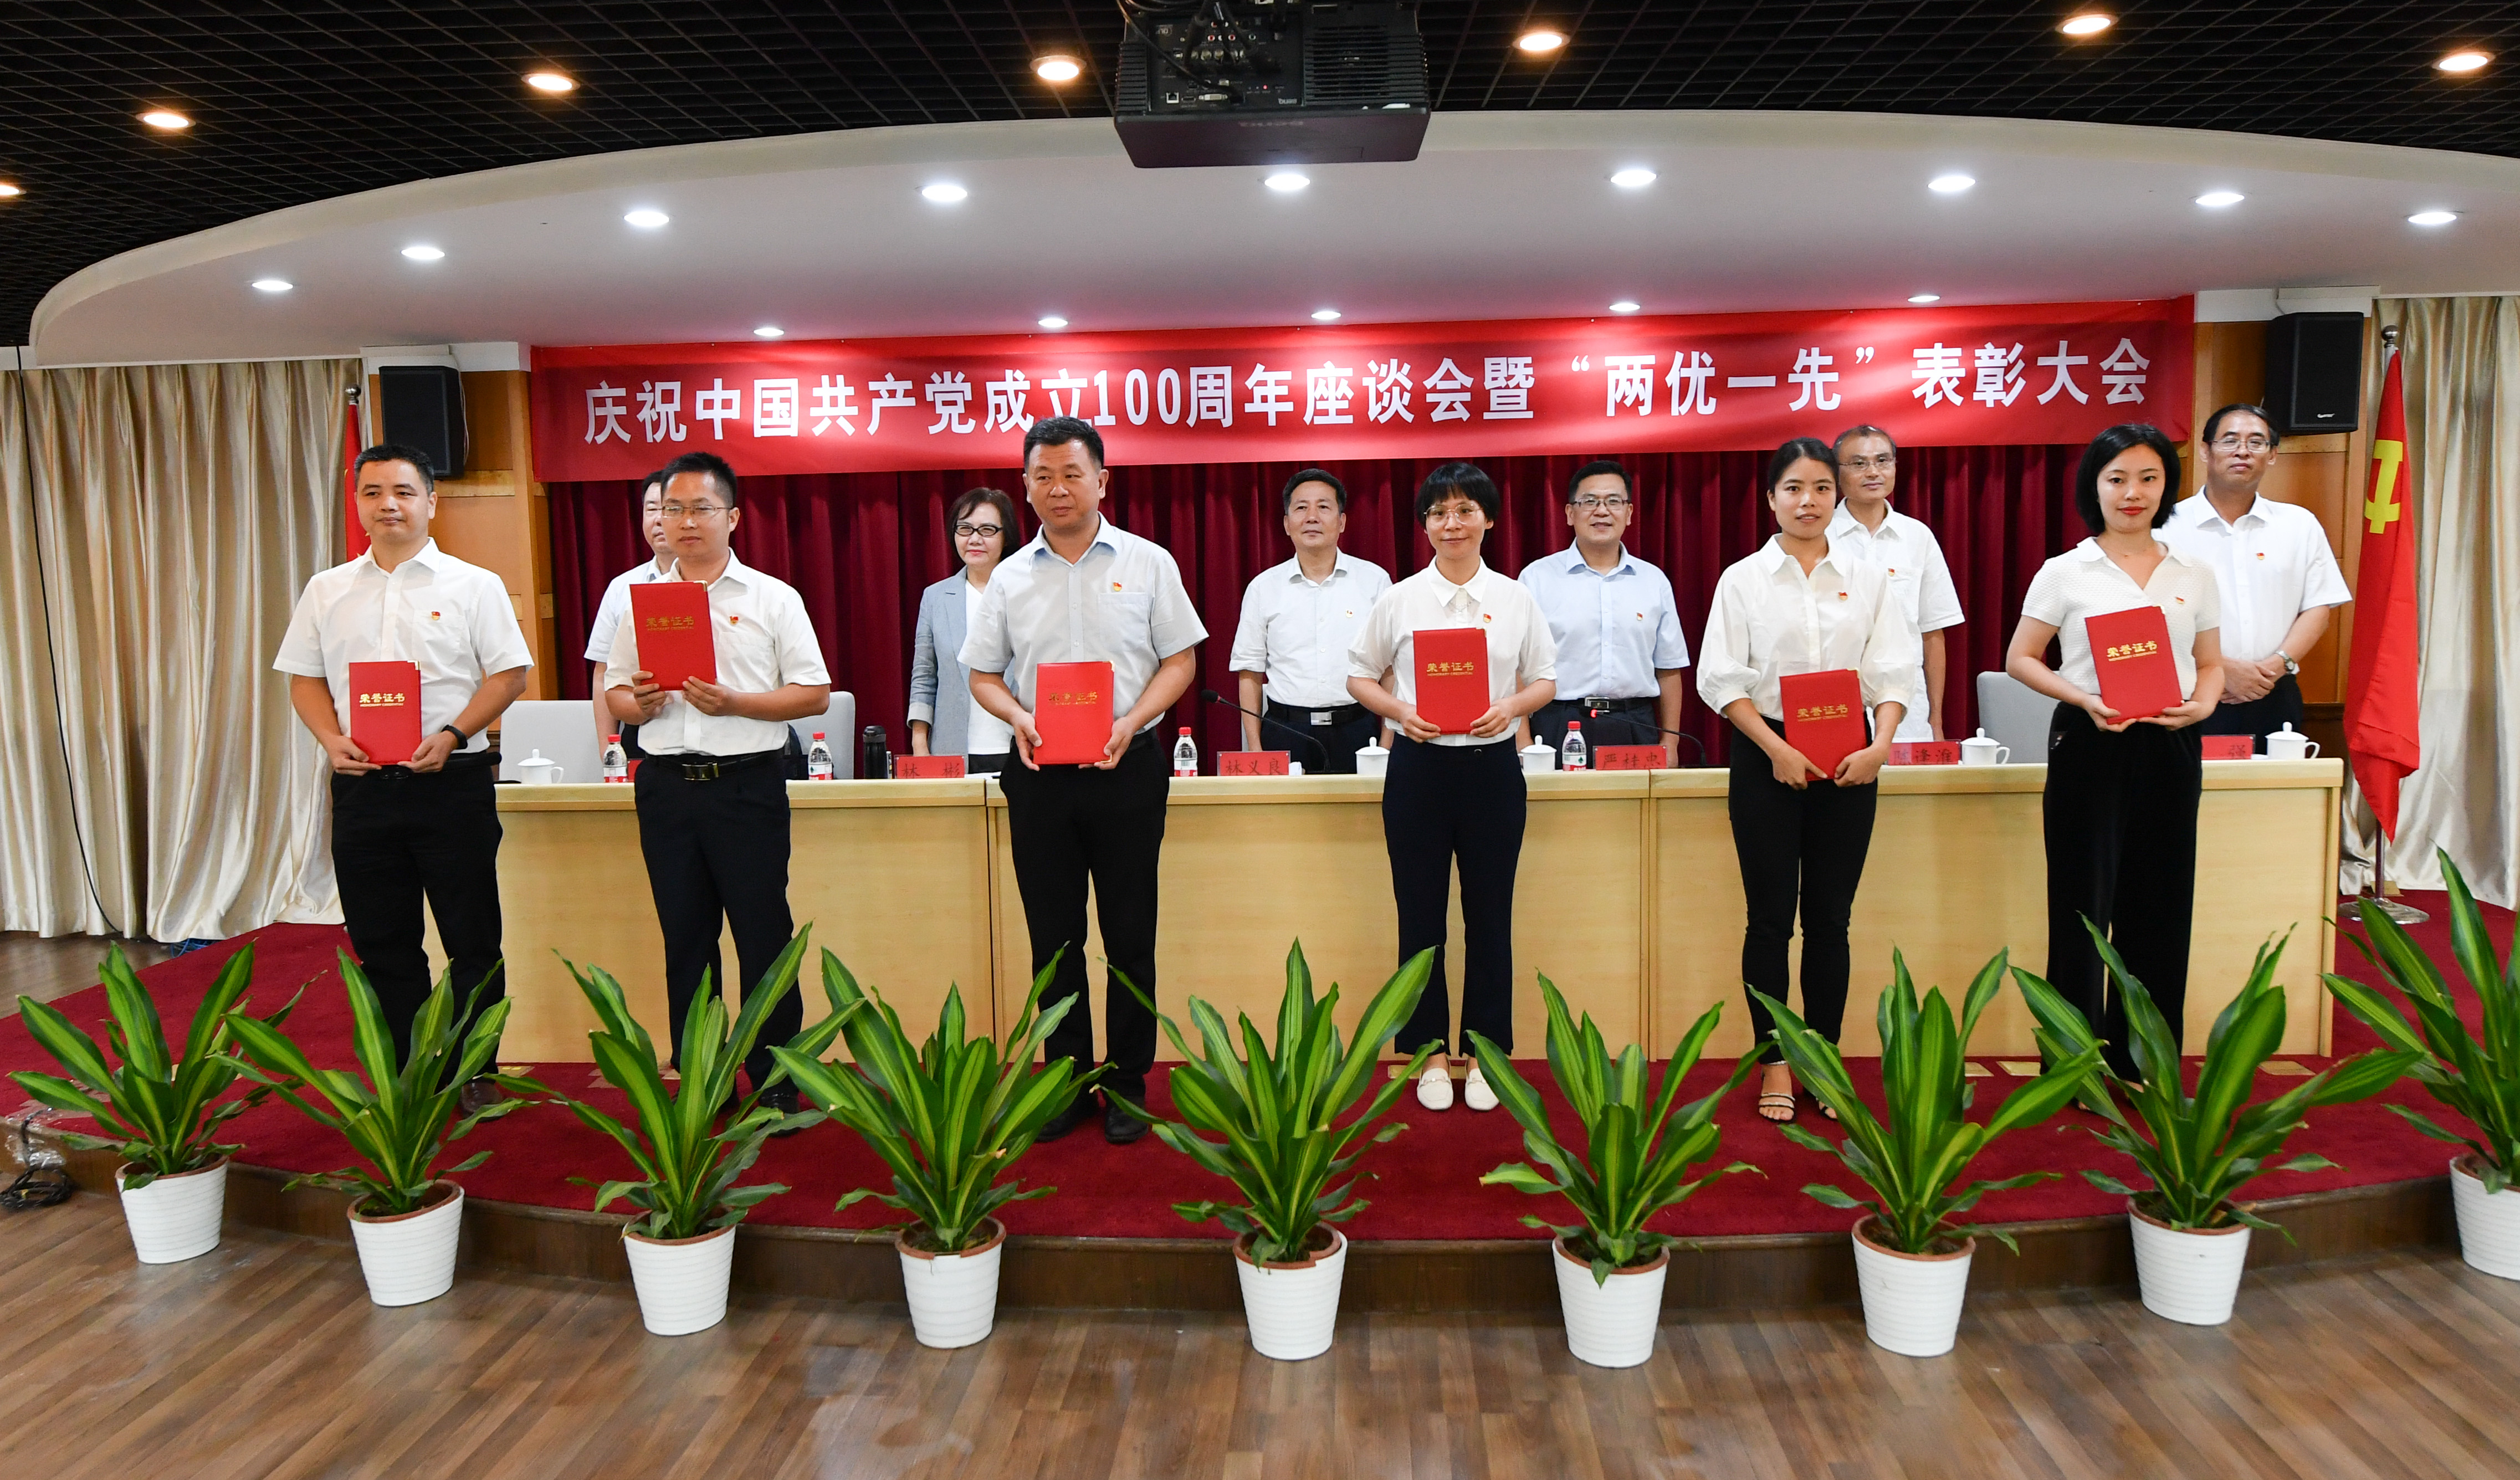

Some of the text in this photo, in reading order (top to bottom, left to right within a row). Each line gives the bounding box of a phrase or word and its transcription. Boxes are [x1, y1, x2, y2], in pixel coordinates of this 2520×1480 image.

[646, 616, 694, 627] 荣誉证书
[2107, 640, 2157, 657] 荣誉证书
[1426, 661, 1474, 672] 荣誉证书
[359, 693, 405, 703] 荣誉证书
[1796, 704, 1848, 718] 荣誉证书
